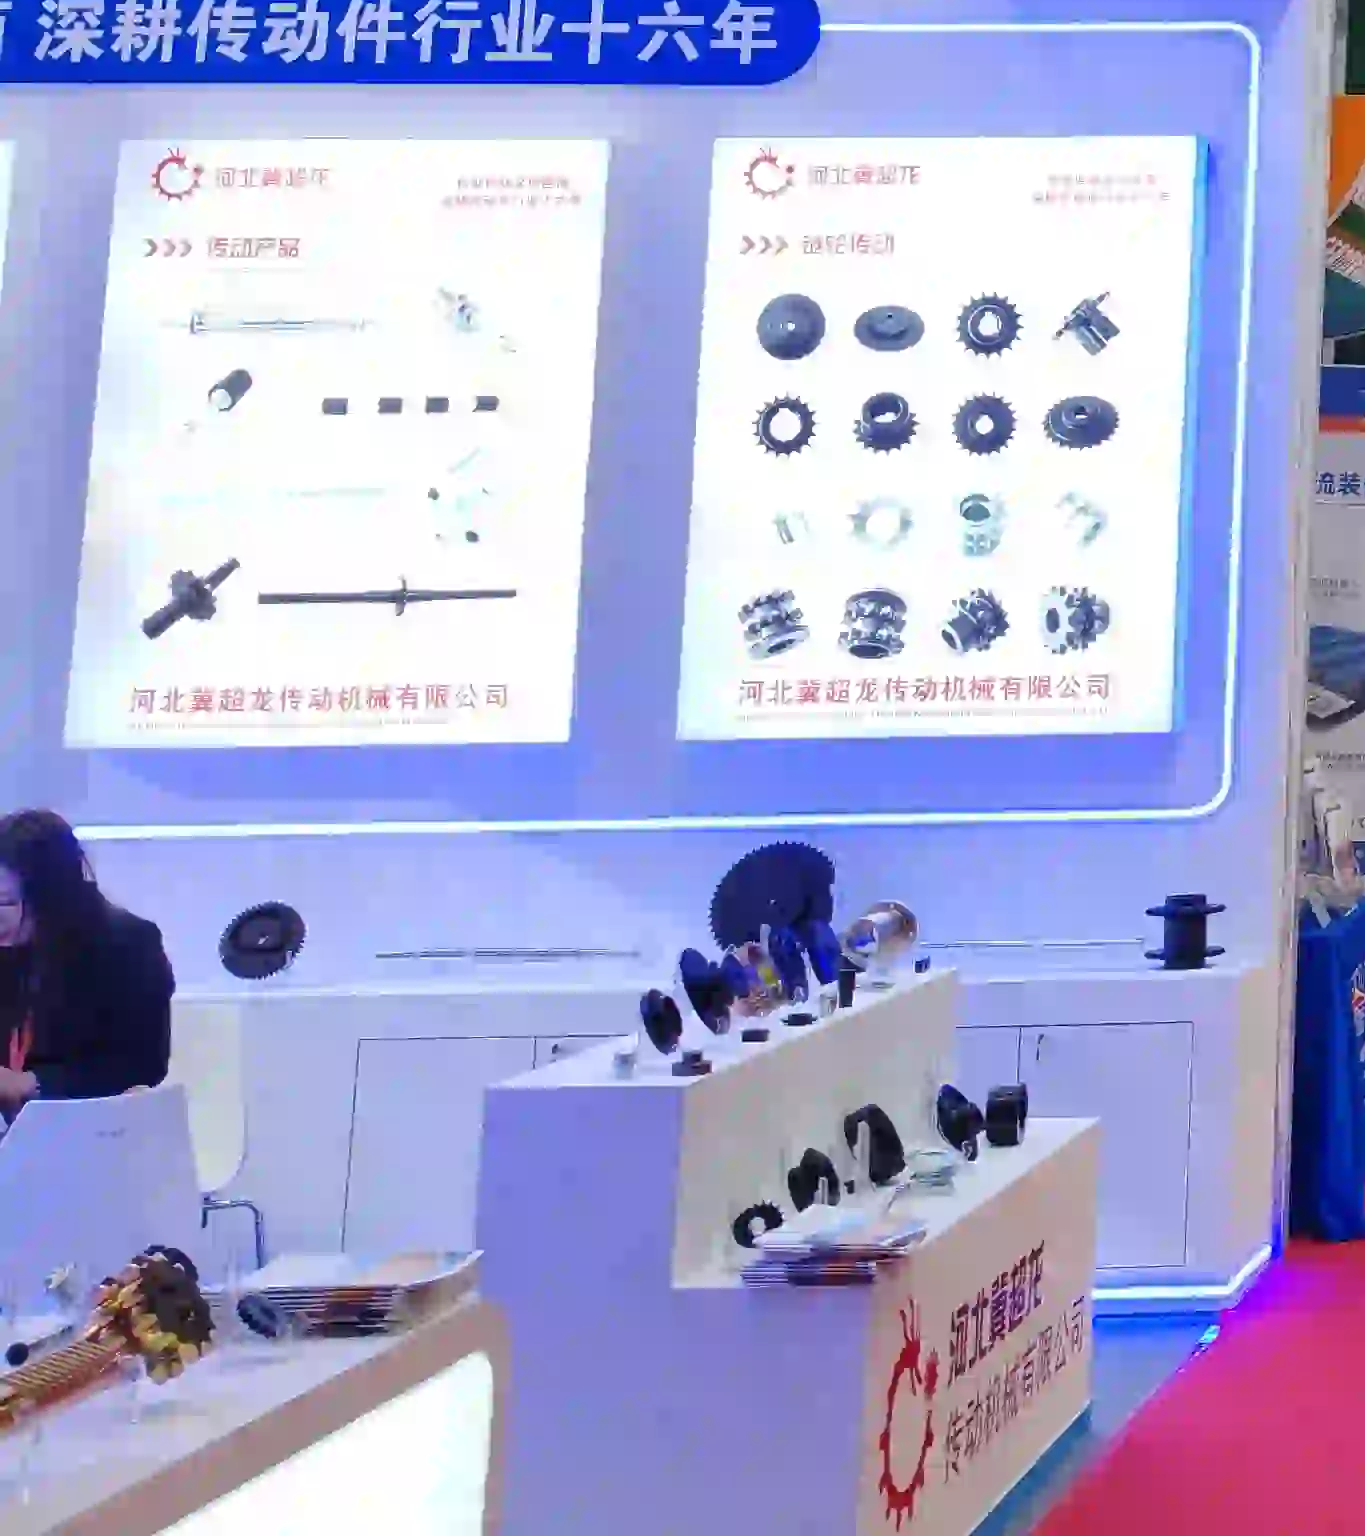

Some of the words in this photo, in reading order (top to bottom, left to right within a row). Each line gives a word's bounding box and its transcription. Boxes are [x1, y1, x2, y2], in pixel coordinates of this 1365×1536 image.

[129, 685, 509, 716] 河北冀超龙传动机械有限公司
[737, 673, 1112, 708] 河北冀超龙传动机械有限公司
